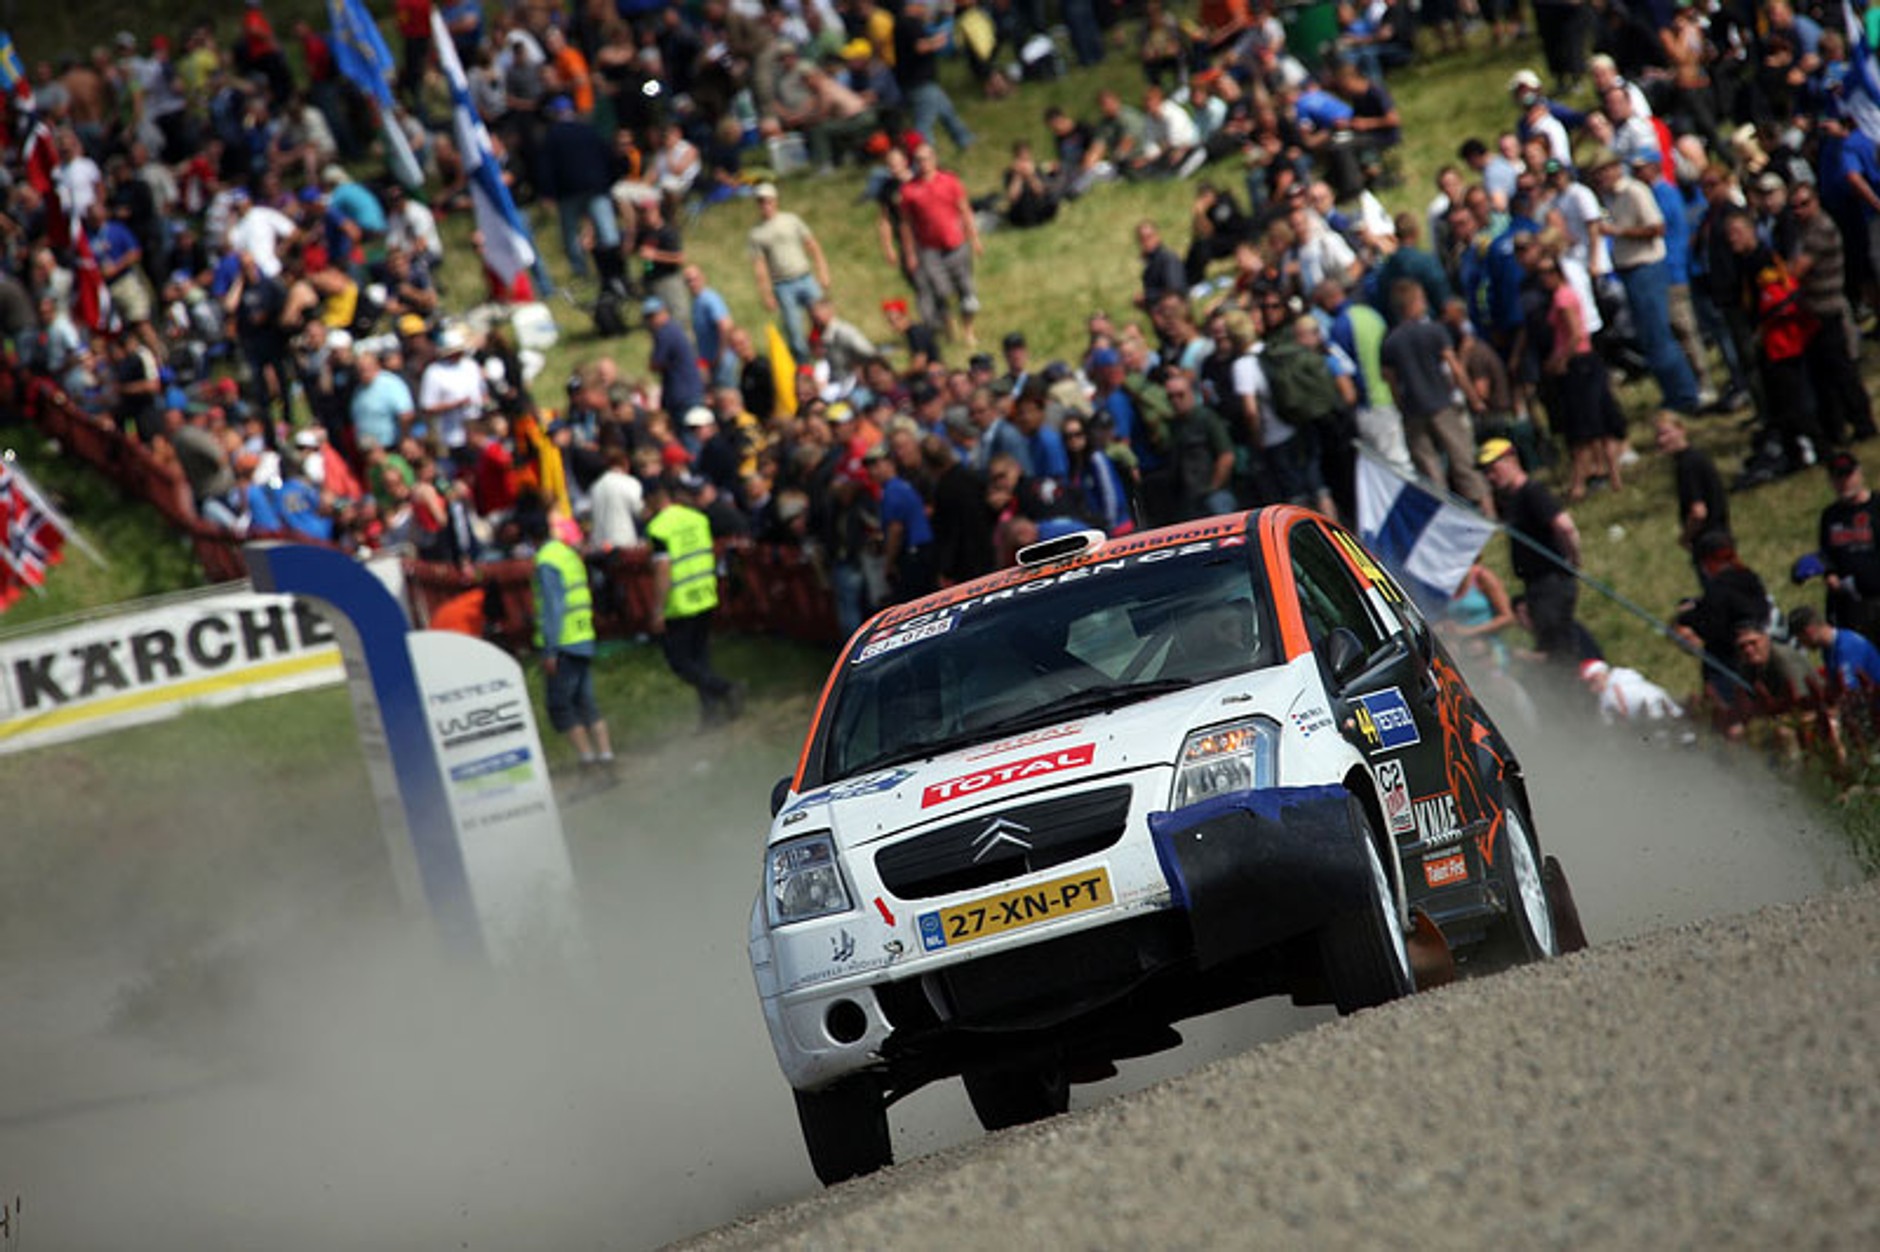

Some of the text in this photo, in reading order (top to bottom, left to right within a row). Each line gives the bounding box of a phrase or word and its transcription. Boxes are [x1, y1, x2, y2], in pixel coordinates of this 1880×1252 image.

[437, 699, 524, 736] WRC
[931, 753, 1087, 797] TOTAL
[948, 877, 1102, 938] 27-XN-PT
